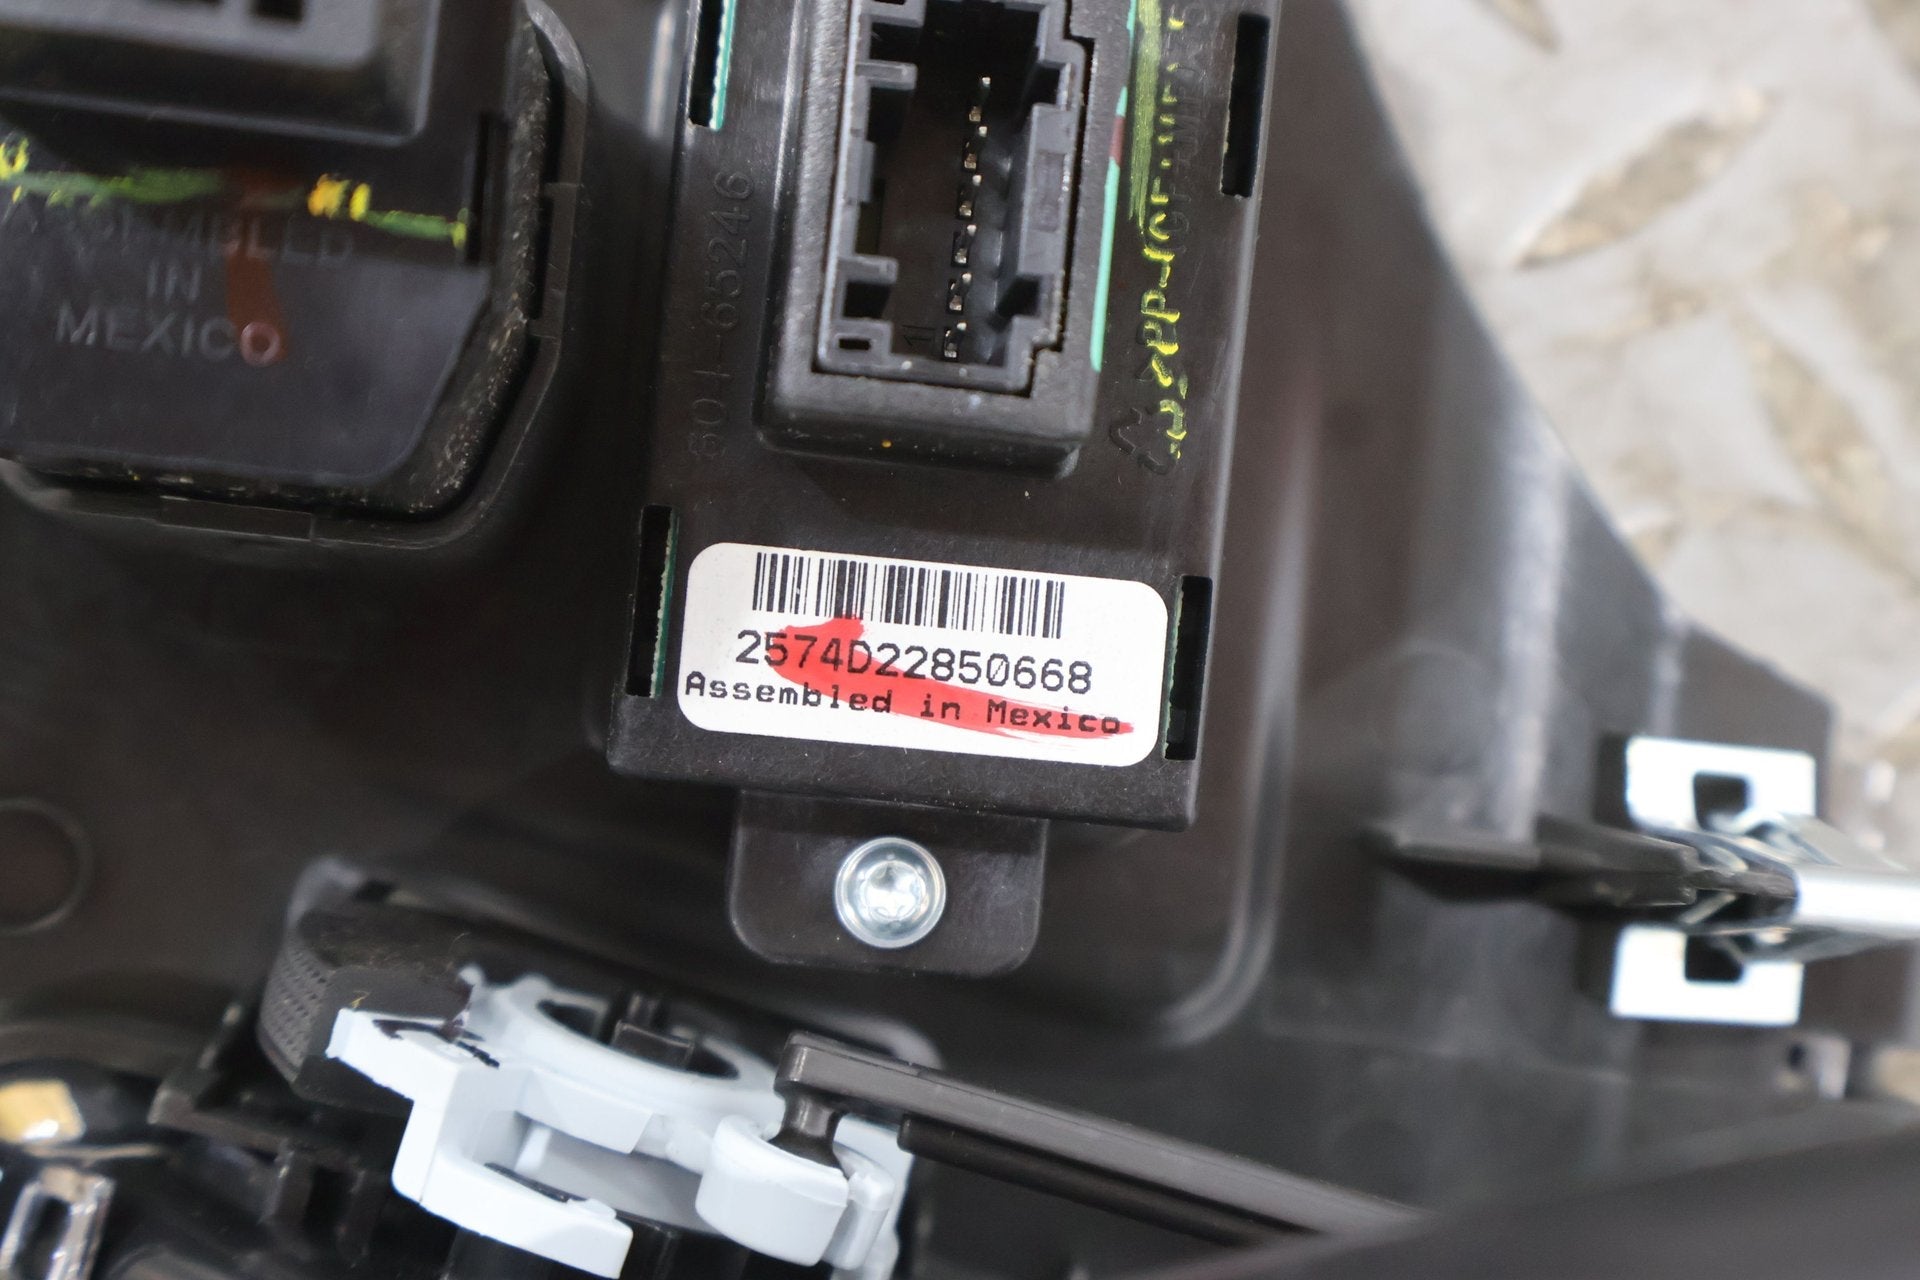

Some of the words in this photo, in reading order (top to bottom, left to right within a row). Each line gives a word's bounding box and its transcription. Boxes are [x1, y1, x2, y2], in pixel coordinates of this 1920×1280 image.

[55, 298, 282, 367] MEXICO
[735, 629, 1092, 695] 2574D22850668
[684, 670, 893, 714] Assembled
[922, 696, 961, 721] in
[987, 700, 1122, 735] Mexico
